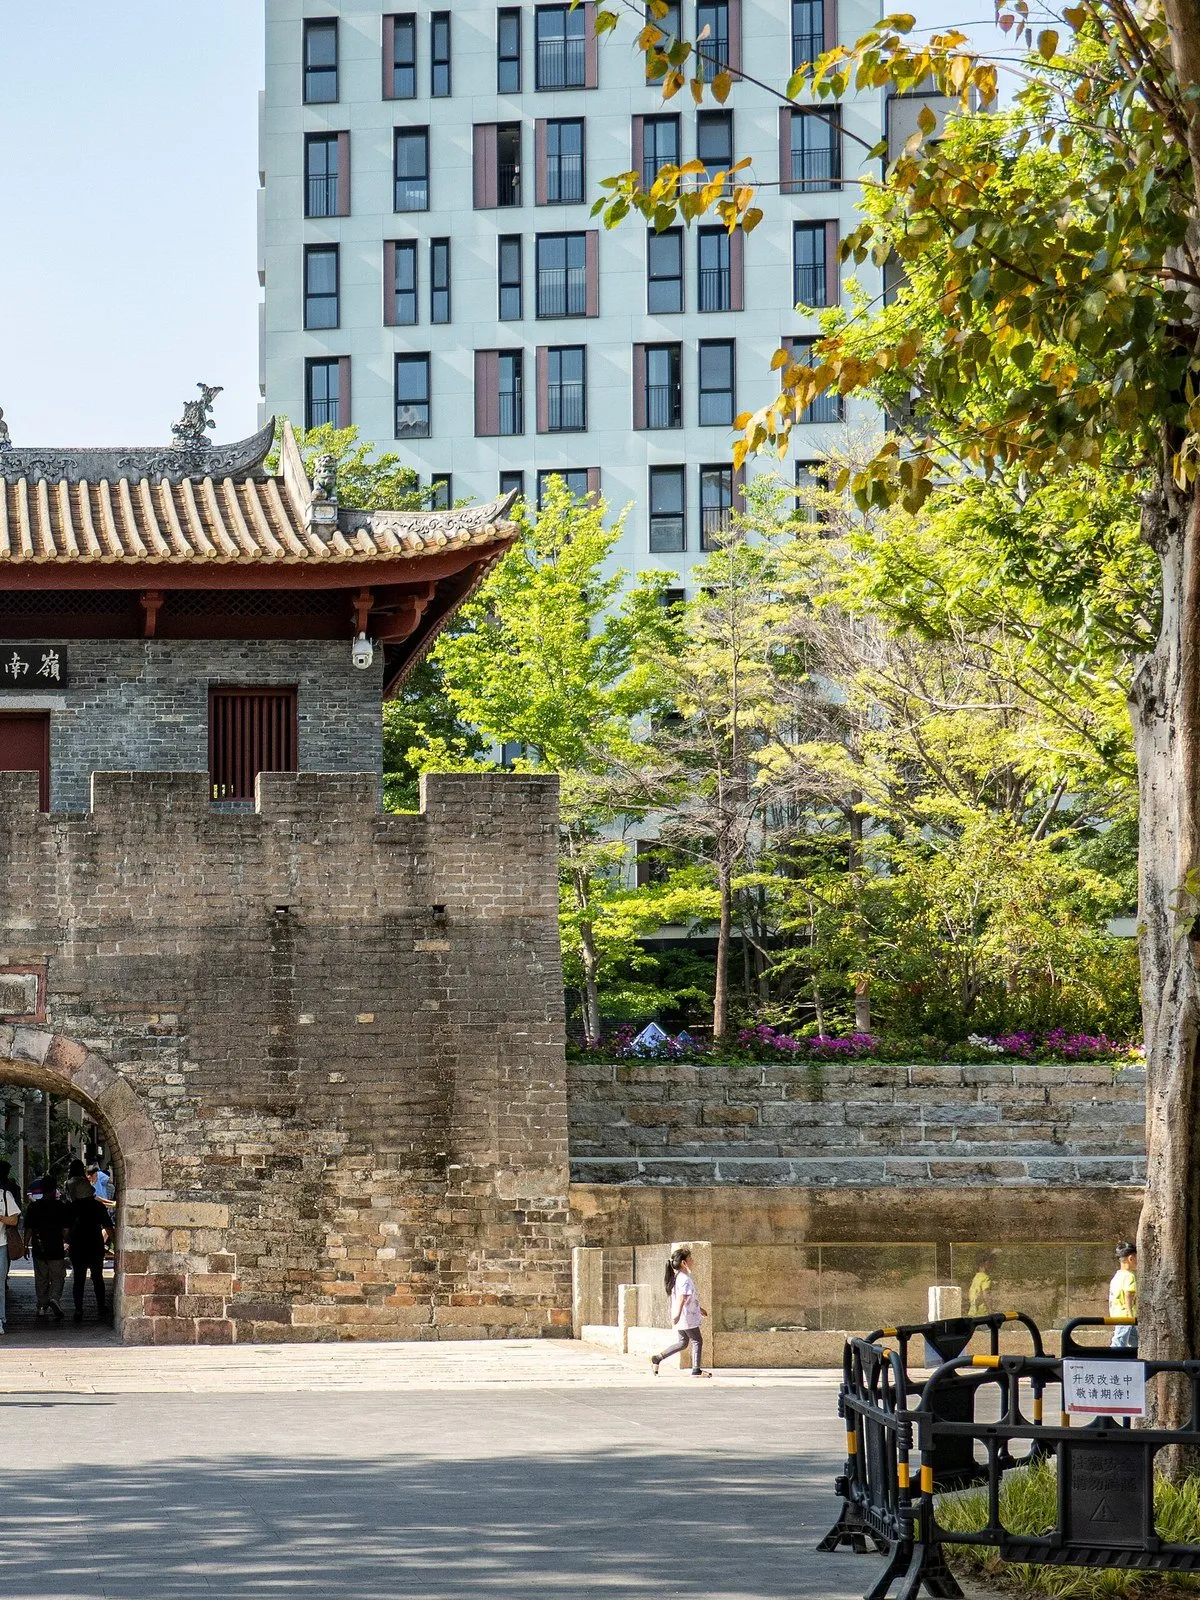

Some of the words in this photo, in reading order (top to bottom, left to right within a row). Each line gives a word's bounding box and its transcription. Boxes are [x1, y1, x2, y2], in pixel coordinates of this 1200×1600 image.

[1072, 1374, 1133, 1386] 升级改造中
